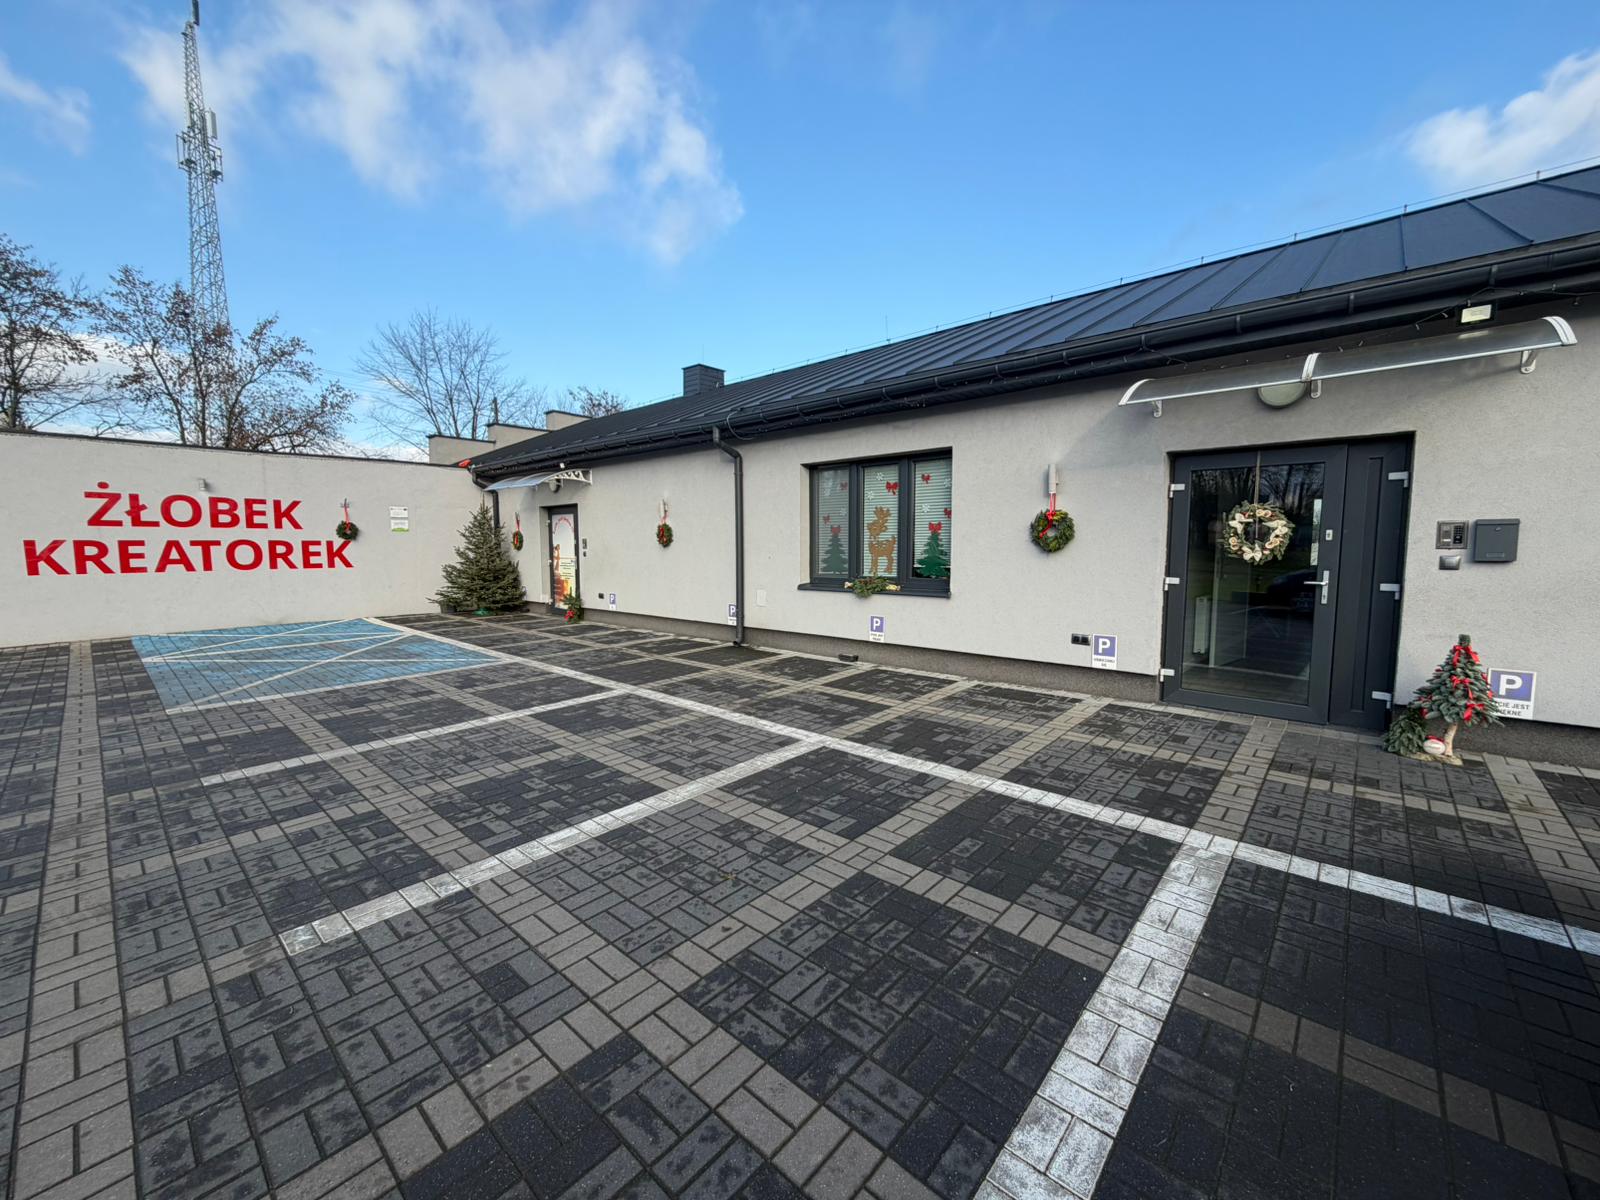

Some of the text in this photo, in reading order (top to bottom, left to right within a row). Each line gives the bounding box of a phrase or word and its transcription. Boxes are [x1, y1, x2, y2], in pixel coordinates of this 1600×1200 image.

[84, 481, 304, 530] ŻŁOBEK
[23, 539, 354, 576] KREATOREK
[873, 617, 881, 631] P
[1098, 638, 1111, 654] P
[1499, 674, 1523, 696] P
